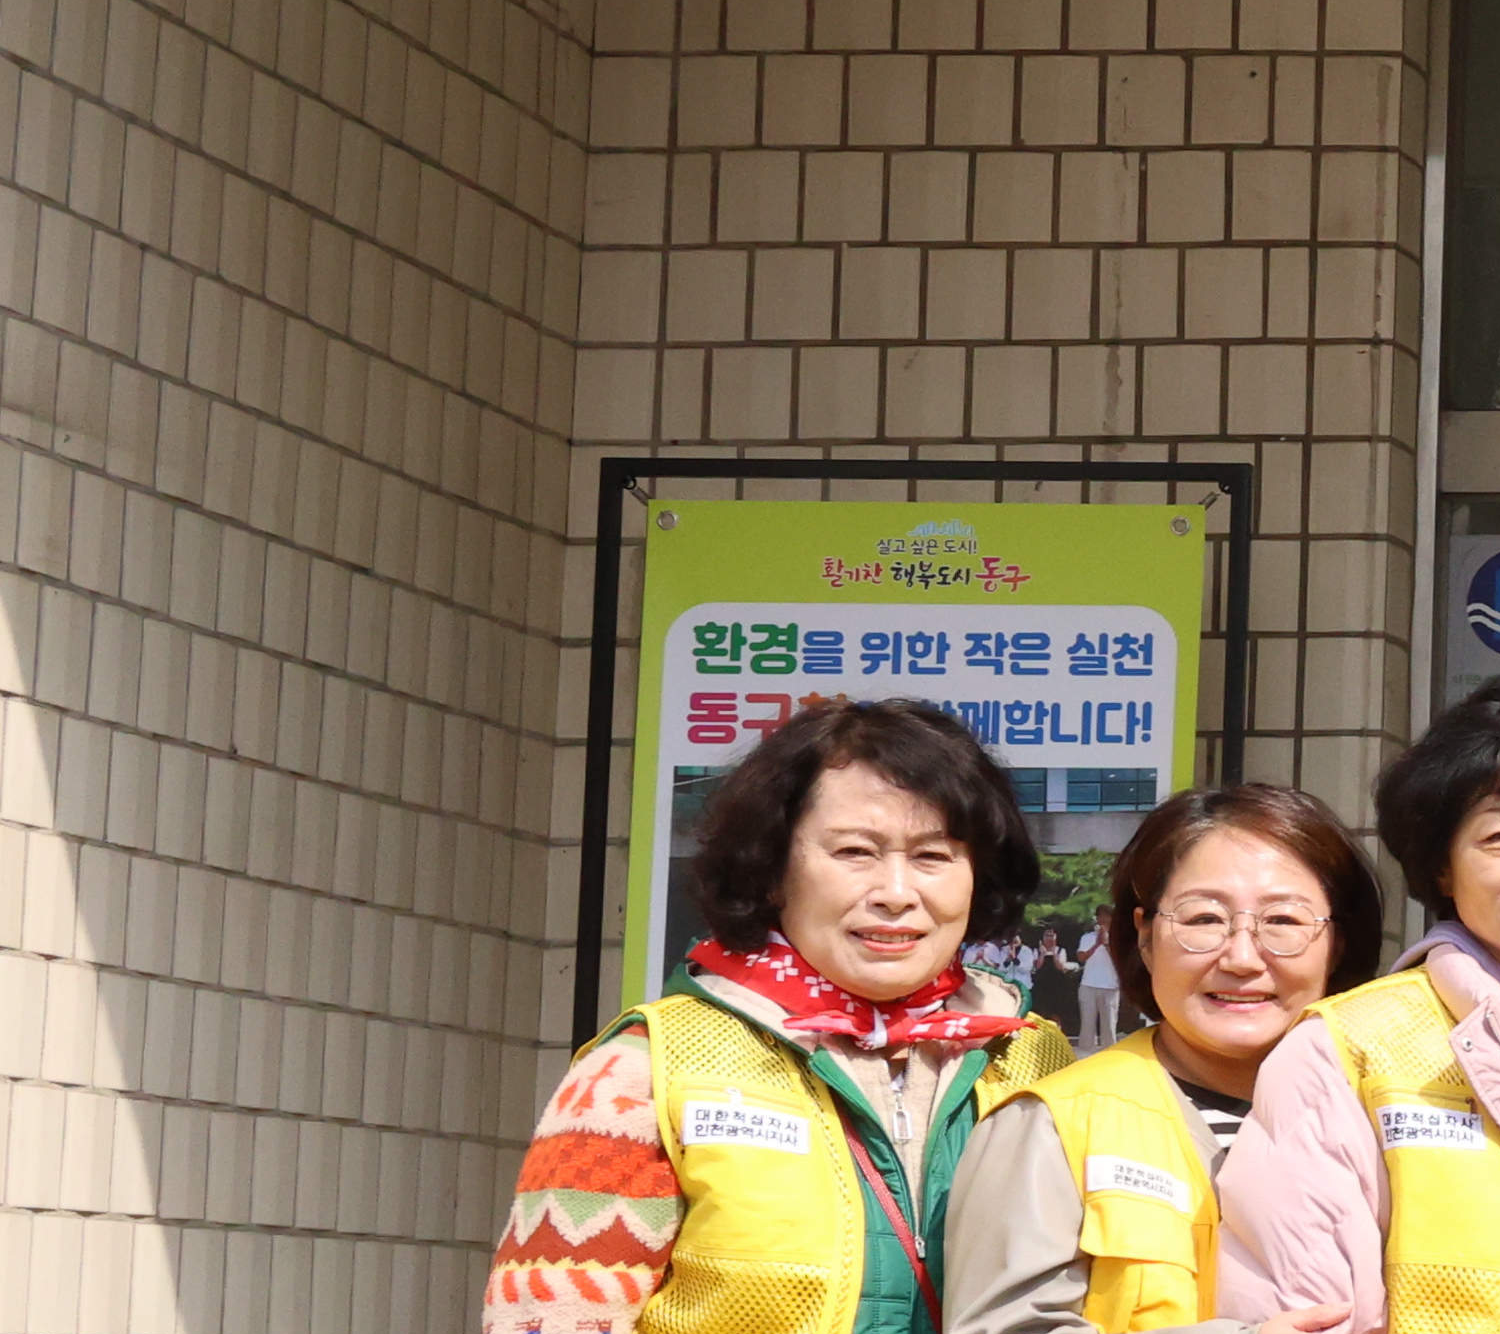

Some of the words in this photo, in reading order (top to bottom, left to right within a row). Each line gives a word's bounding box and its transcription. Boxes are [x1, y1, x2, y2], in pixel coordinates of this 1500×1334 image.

[877, 539, 906, 555] 살고
[910, 539, 939, 555] 싶은
[943, 539, 977, 555] 도시!
[822, 558, 883, 587] 활기찬
[890, 560, 970, 589] 행복도시
[975, 557, 1031, 591] 동구
[692, 622, 844, 675] 환경을
[861, 631, 949, 675] 위한
[965, 632, 1051, 675] 작은
[1067, 633, 1153, 676] 실천
